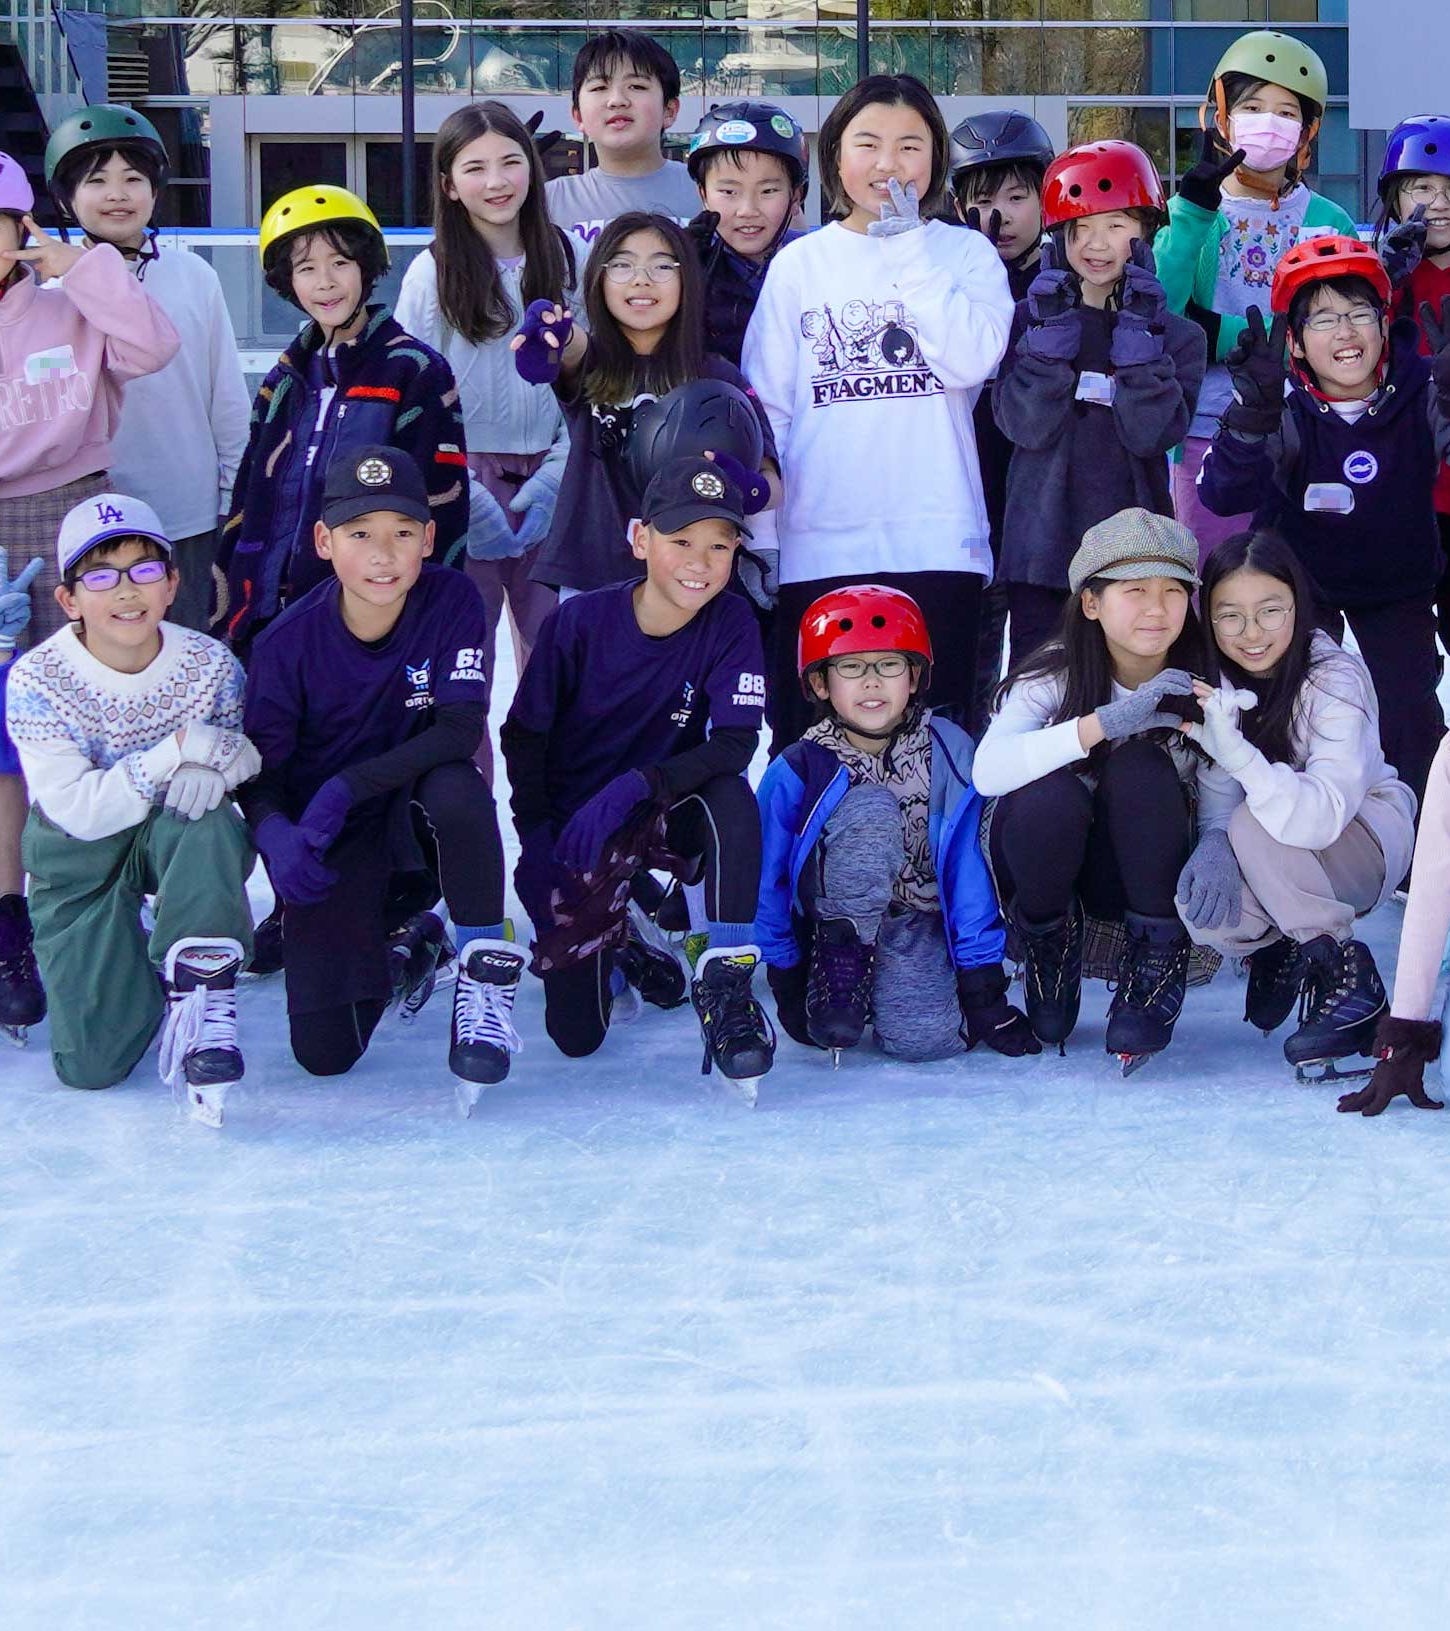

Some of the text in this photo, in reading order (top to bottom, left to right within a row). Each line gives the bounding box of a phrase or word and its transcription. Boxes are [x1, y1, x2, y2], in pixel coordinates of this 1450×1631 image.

[94, 503, 125, 525] LA
[738, 672, 766, 695] 88
[732, 693, 765, 707] TOSH
[482, 955, 519, 968] CCM
